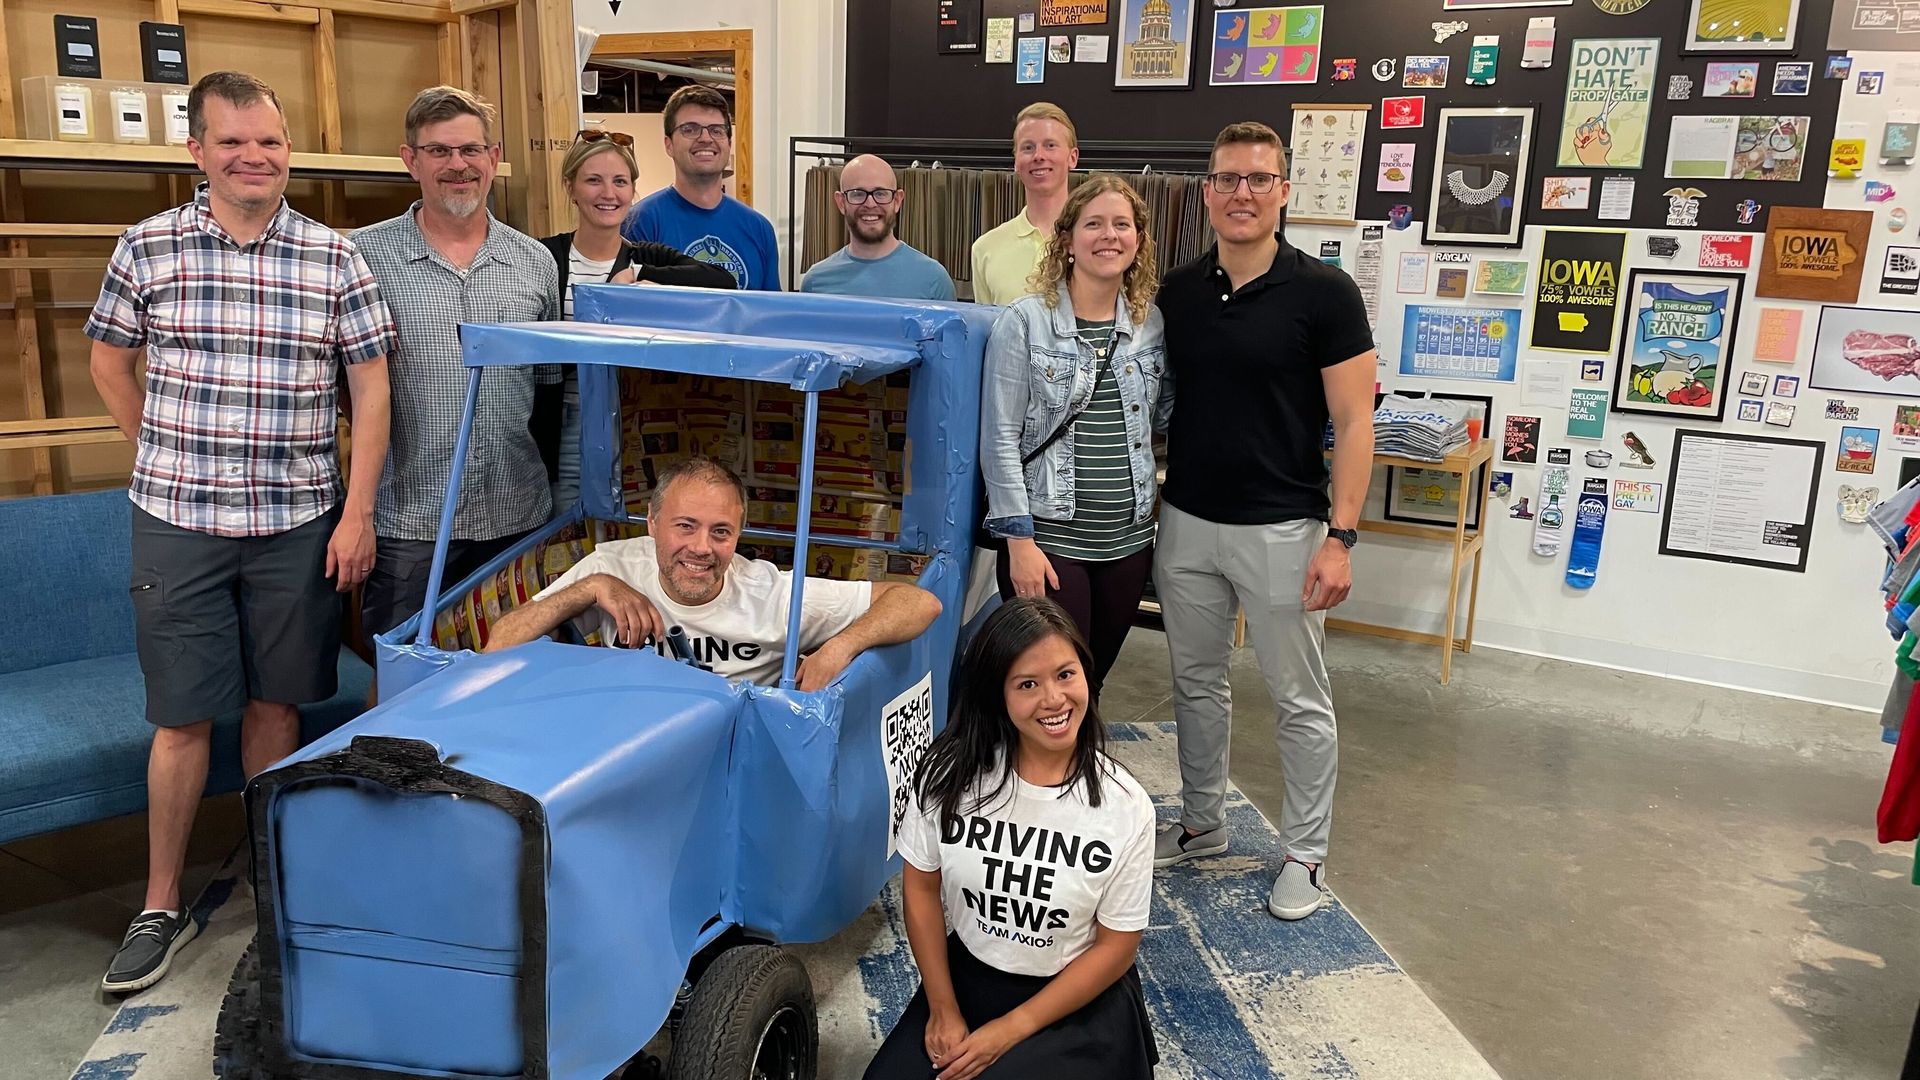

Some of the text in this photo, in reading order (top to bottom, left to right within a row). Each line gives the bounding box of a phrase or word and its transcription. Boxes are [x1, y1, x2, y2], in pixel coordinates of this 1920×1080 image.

[1042, 4, 1106, 16] INSPIRATIONAL
[1041, 16, 1063, 24] WALL
[1065, 15, 1082, 24] ART.
[1576, 46, 1652, 66] DON'T
[1573, 69, 1638, 90] HATE,
[1782, 236, 1839, 257] IOWA
[720, 244, 744, 275] BREWERS
[1435, 252, 1472, 262] RAYGUN
[1781, 254, 1839, 264] 75% VOWELS
[1542, 258, 1616, 287] IOWA
[1541, 284, 1615, 298] 75% VOWELS
[1539, 294, 1564, 304] 100%
[1418, 307, 1448, 315] MIDWEST
[1468, 309, 1504, 317] FORECAST
[1647, 322, 1708, 337] RANCH
[1571, 392, 1608, 401] WELCOME
[1826, 405, 1859, 414] COOLER
[1569, 413, 1596, 421] WORLD.
[1617, 482, 1639, 492] THIS
[1616, 491, 1654, 501] PRETTY
[1615, 499, 1634, 508] GAY.
[940, 813, 1112, 874] DRIVING
[982, 856, 1056, 902] THE
[961, 886, 1070, 932] NEWS
[976, 917, 1054, 948] TEAM AXIOS
